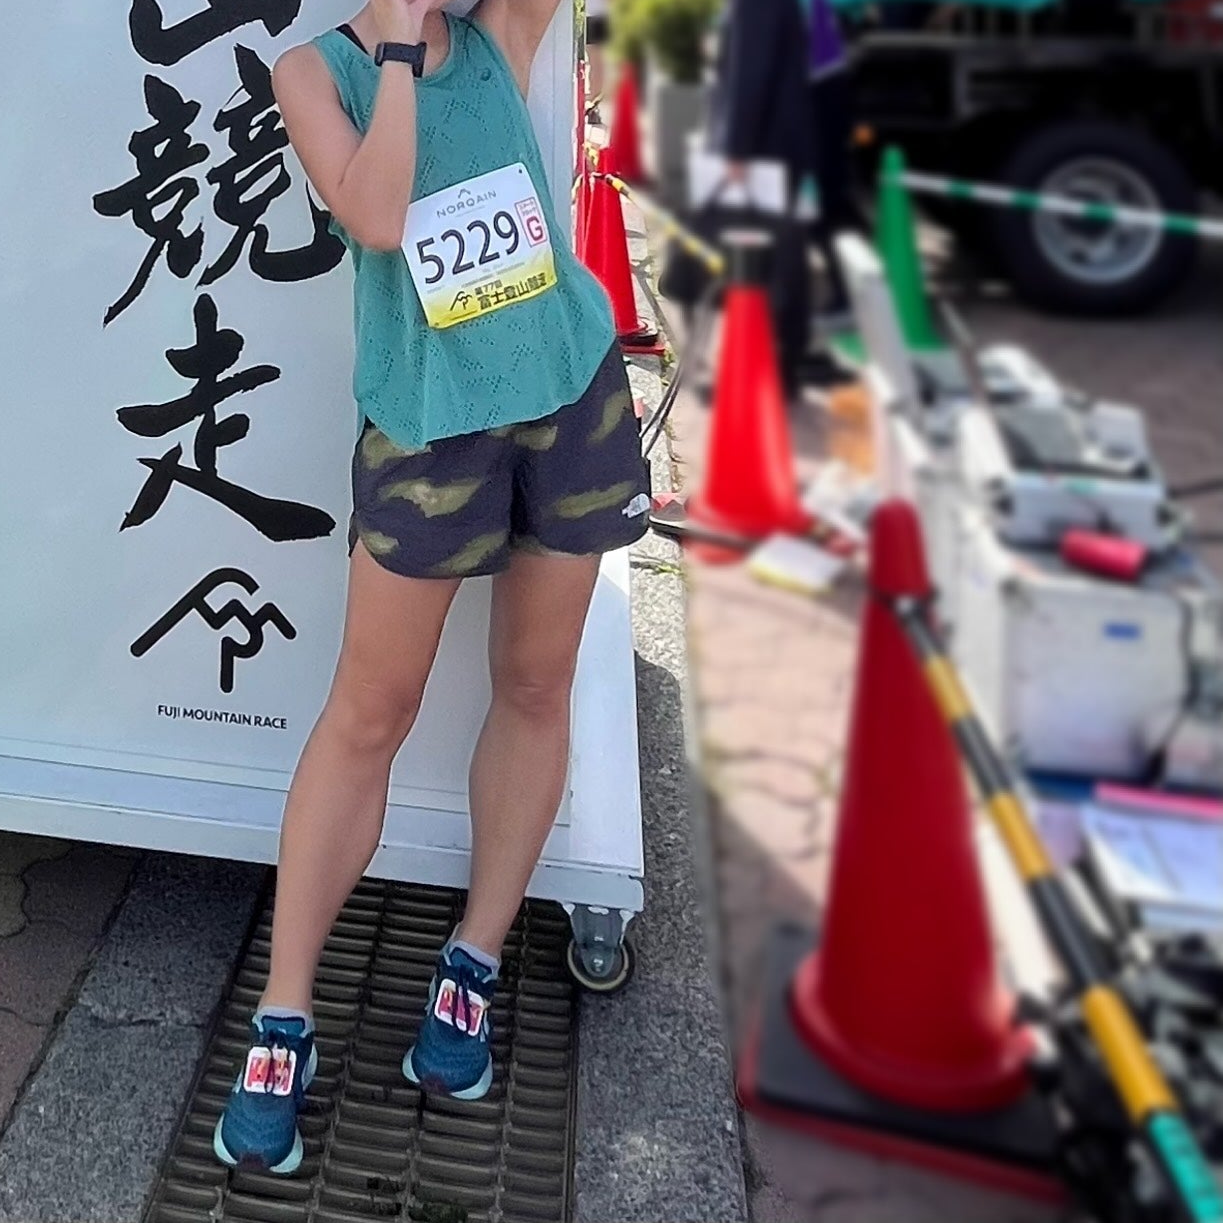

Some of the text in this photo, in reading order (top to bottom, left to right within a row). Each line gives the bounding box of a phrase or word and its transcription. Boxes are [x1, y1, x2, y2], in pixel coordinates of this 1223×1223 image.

[435, 190, 498, 219] NORQAIN
[526, 215, 544, 242] G
[416, 210, 520, 285] 5229
[157, 704, 287, 730] FUJI MOUNTAIN RACE
